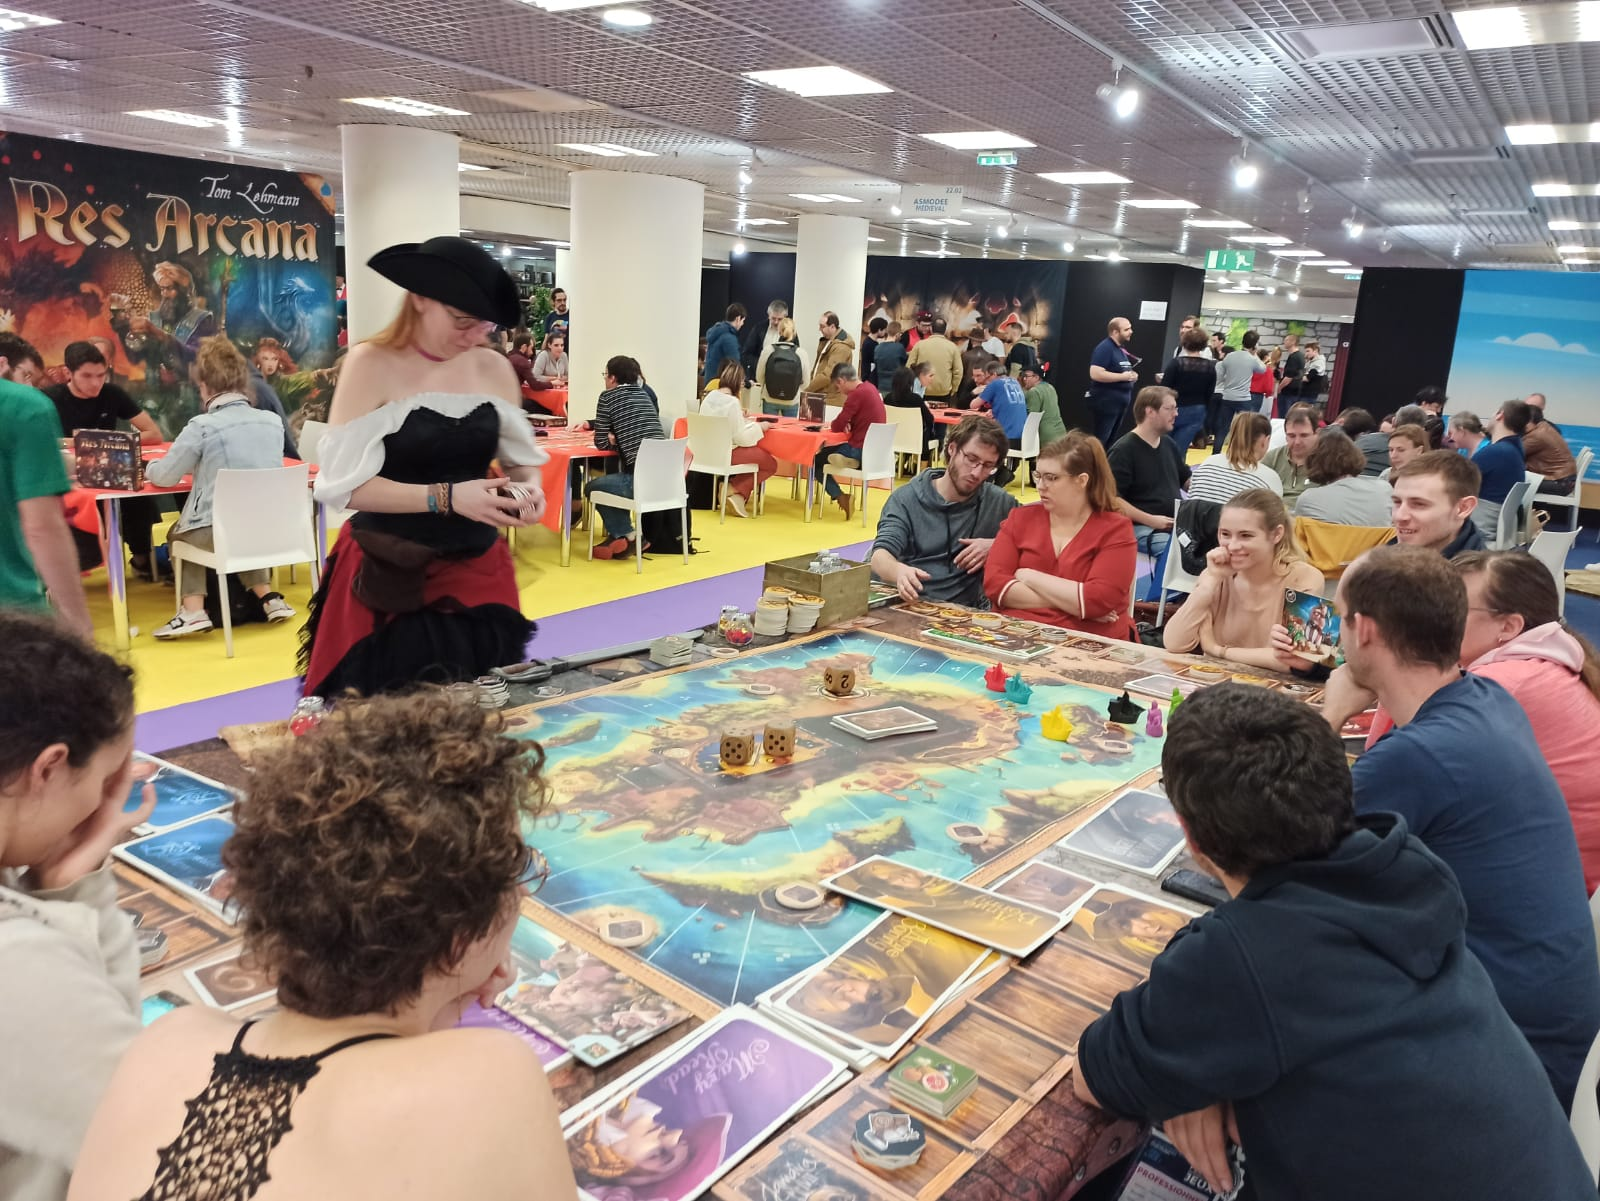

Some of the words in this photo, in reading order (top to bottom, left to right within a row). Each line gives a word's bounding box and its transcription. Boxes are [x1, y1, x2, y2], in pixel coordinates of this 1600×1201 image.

[9, 177, 131, 249] Res
[146, 192, 319, 262] Arcana
[200, 174, 231, 200] Tom
[236, 182, 300, 214] Lehmann
[664, 1042, 728, 1095] Read
[695, 1039, 769, 1094] Mary
